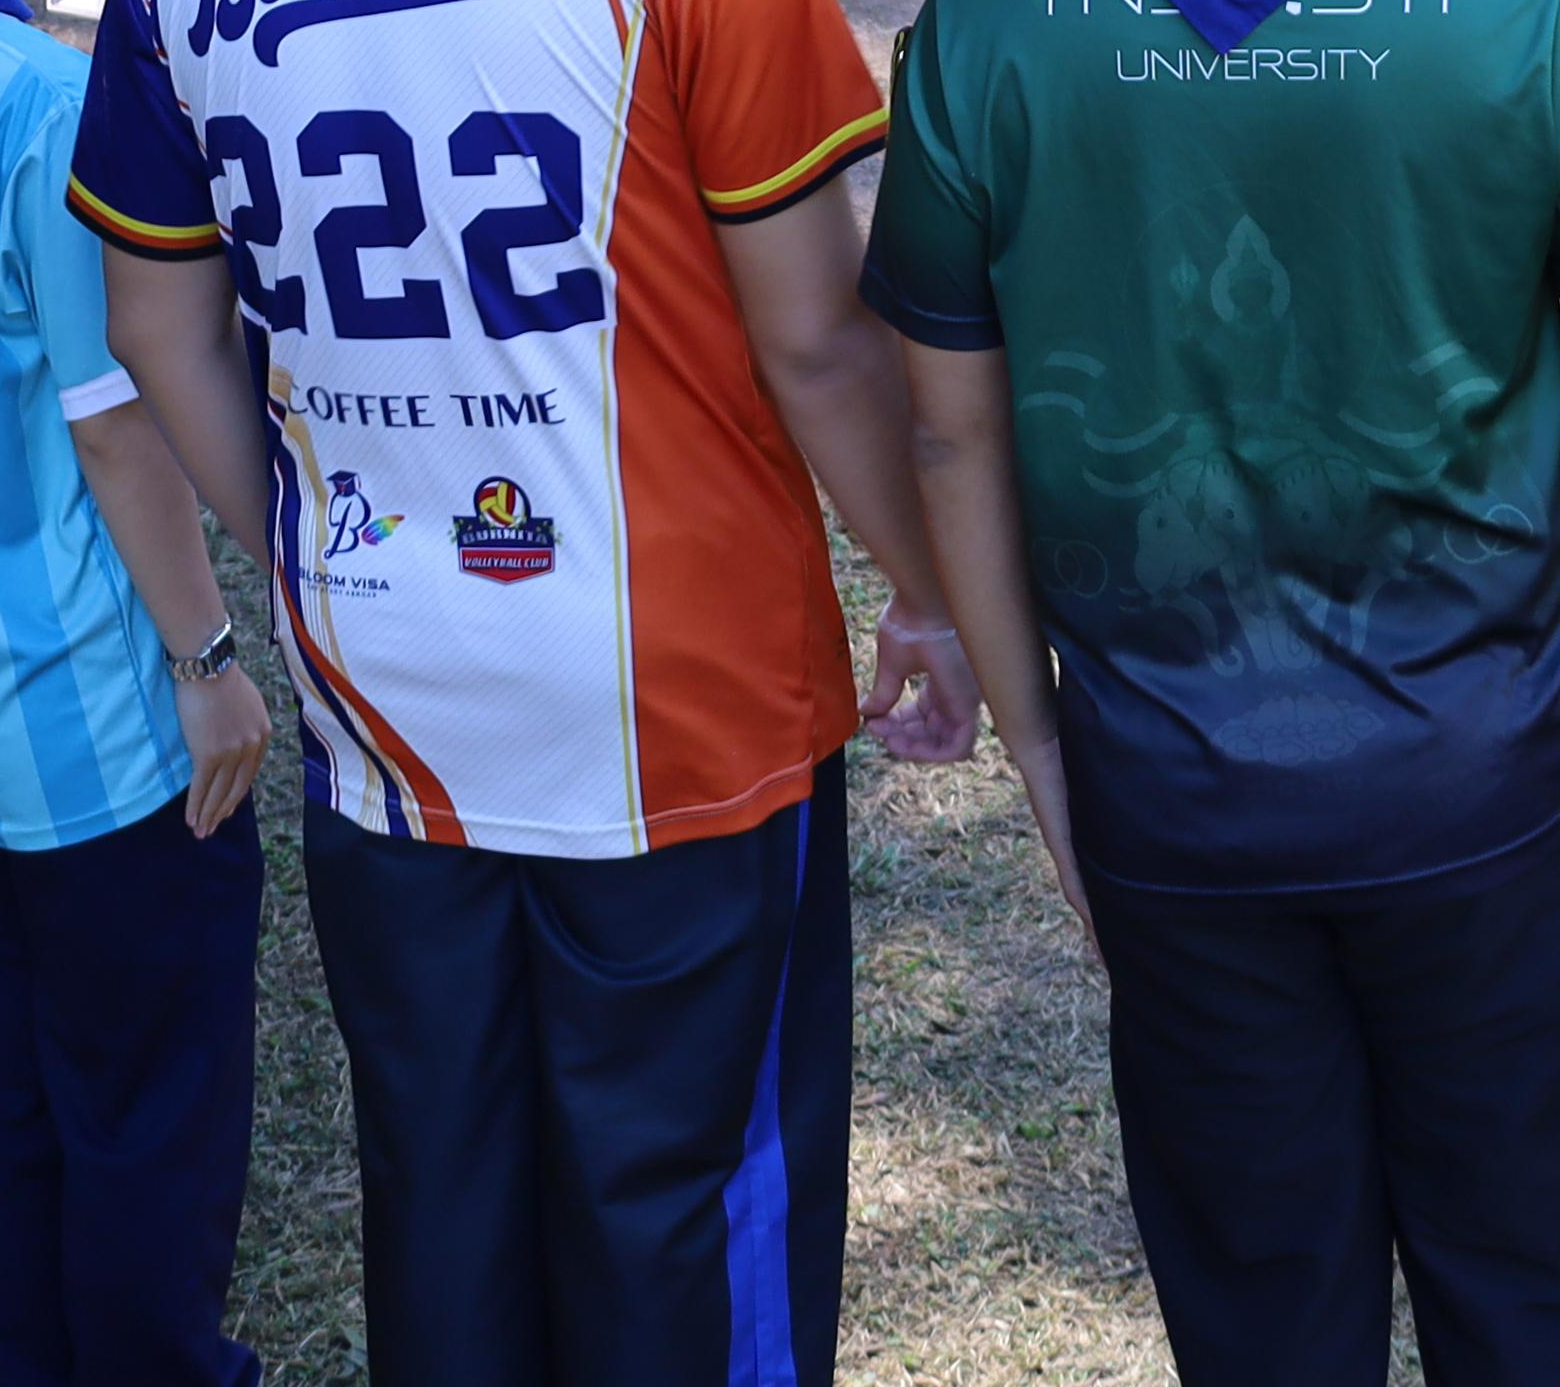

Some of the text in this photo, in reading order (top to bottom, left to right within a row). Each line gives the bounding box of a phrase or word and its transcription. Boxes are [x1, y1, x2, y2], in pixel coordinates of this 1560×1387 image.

[1116, 48, 1391, 82] UNIVERSITY
[205, 109, 607, 340] 222
[288, 384, 567, 428] COFFEE TIME
[351, 577, 390, 591] VISA
